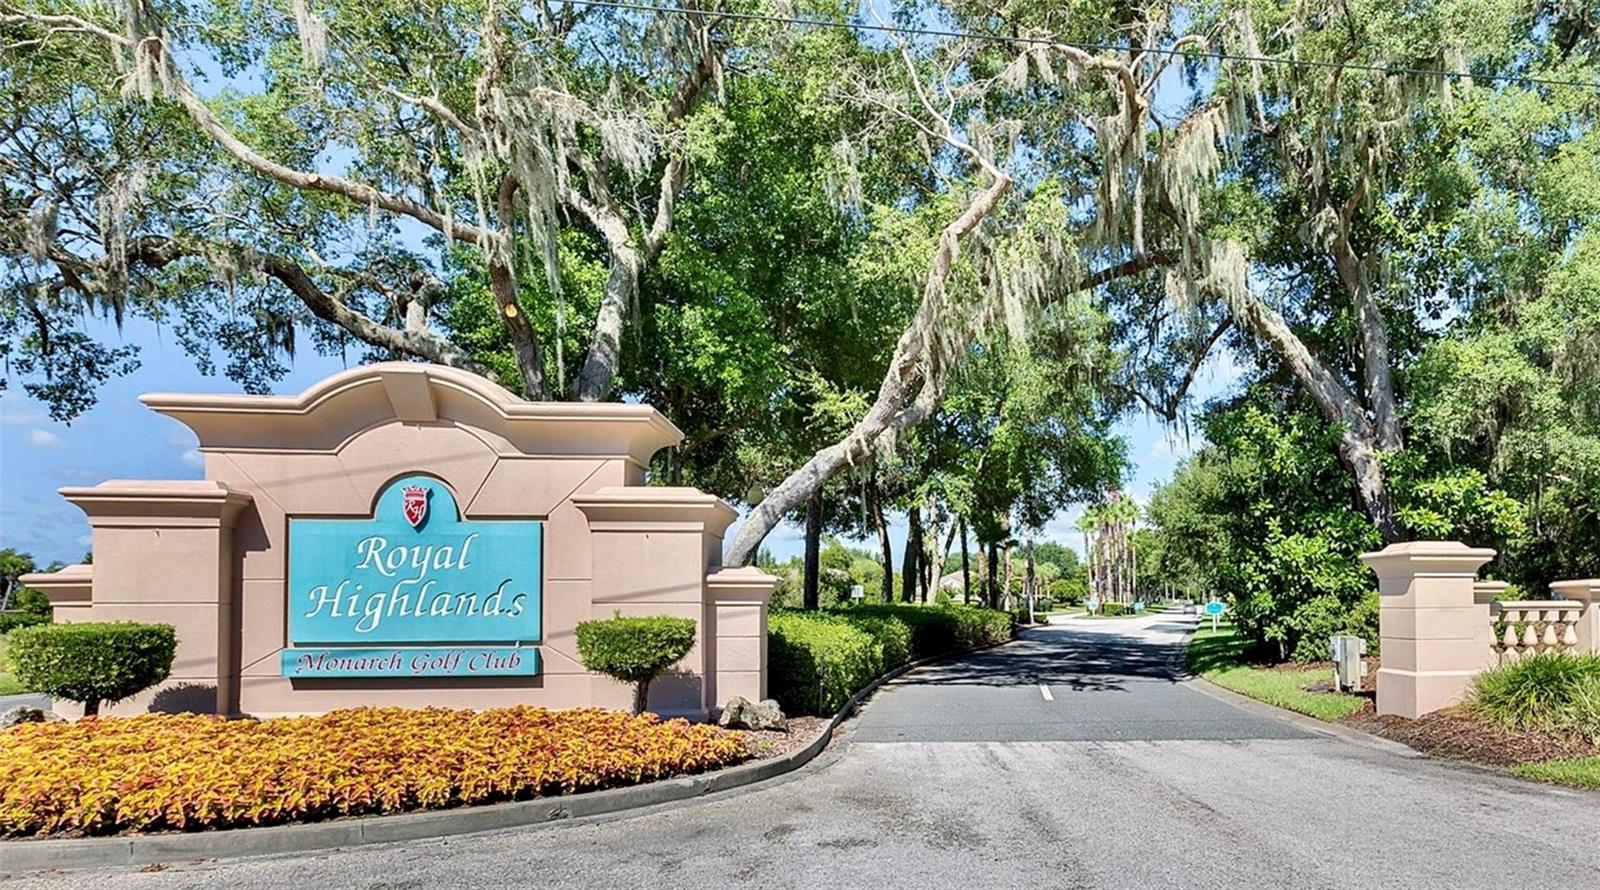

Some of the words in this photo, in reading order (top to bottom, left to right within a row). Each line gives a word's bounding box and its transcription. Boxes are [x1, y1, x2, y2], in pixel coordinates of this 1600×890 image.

[354, 532, 480, 584] Royal
[304, 577, 528, 633] Highlands
[296, 650, 402, 673] Monarch
[410, 649, 466, 674] Golf
[468, 649, 521, 672] Club
